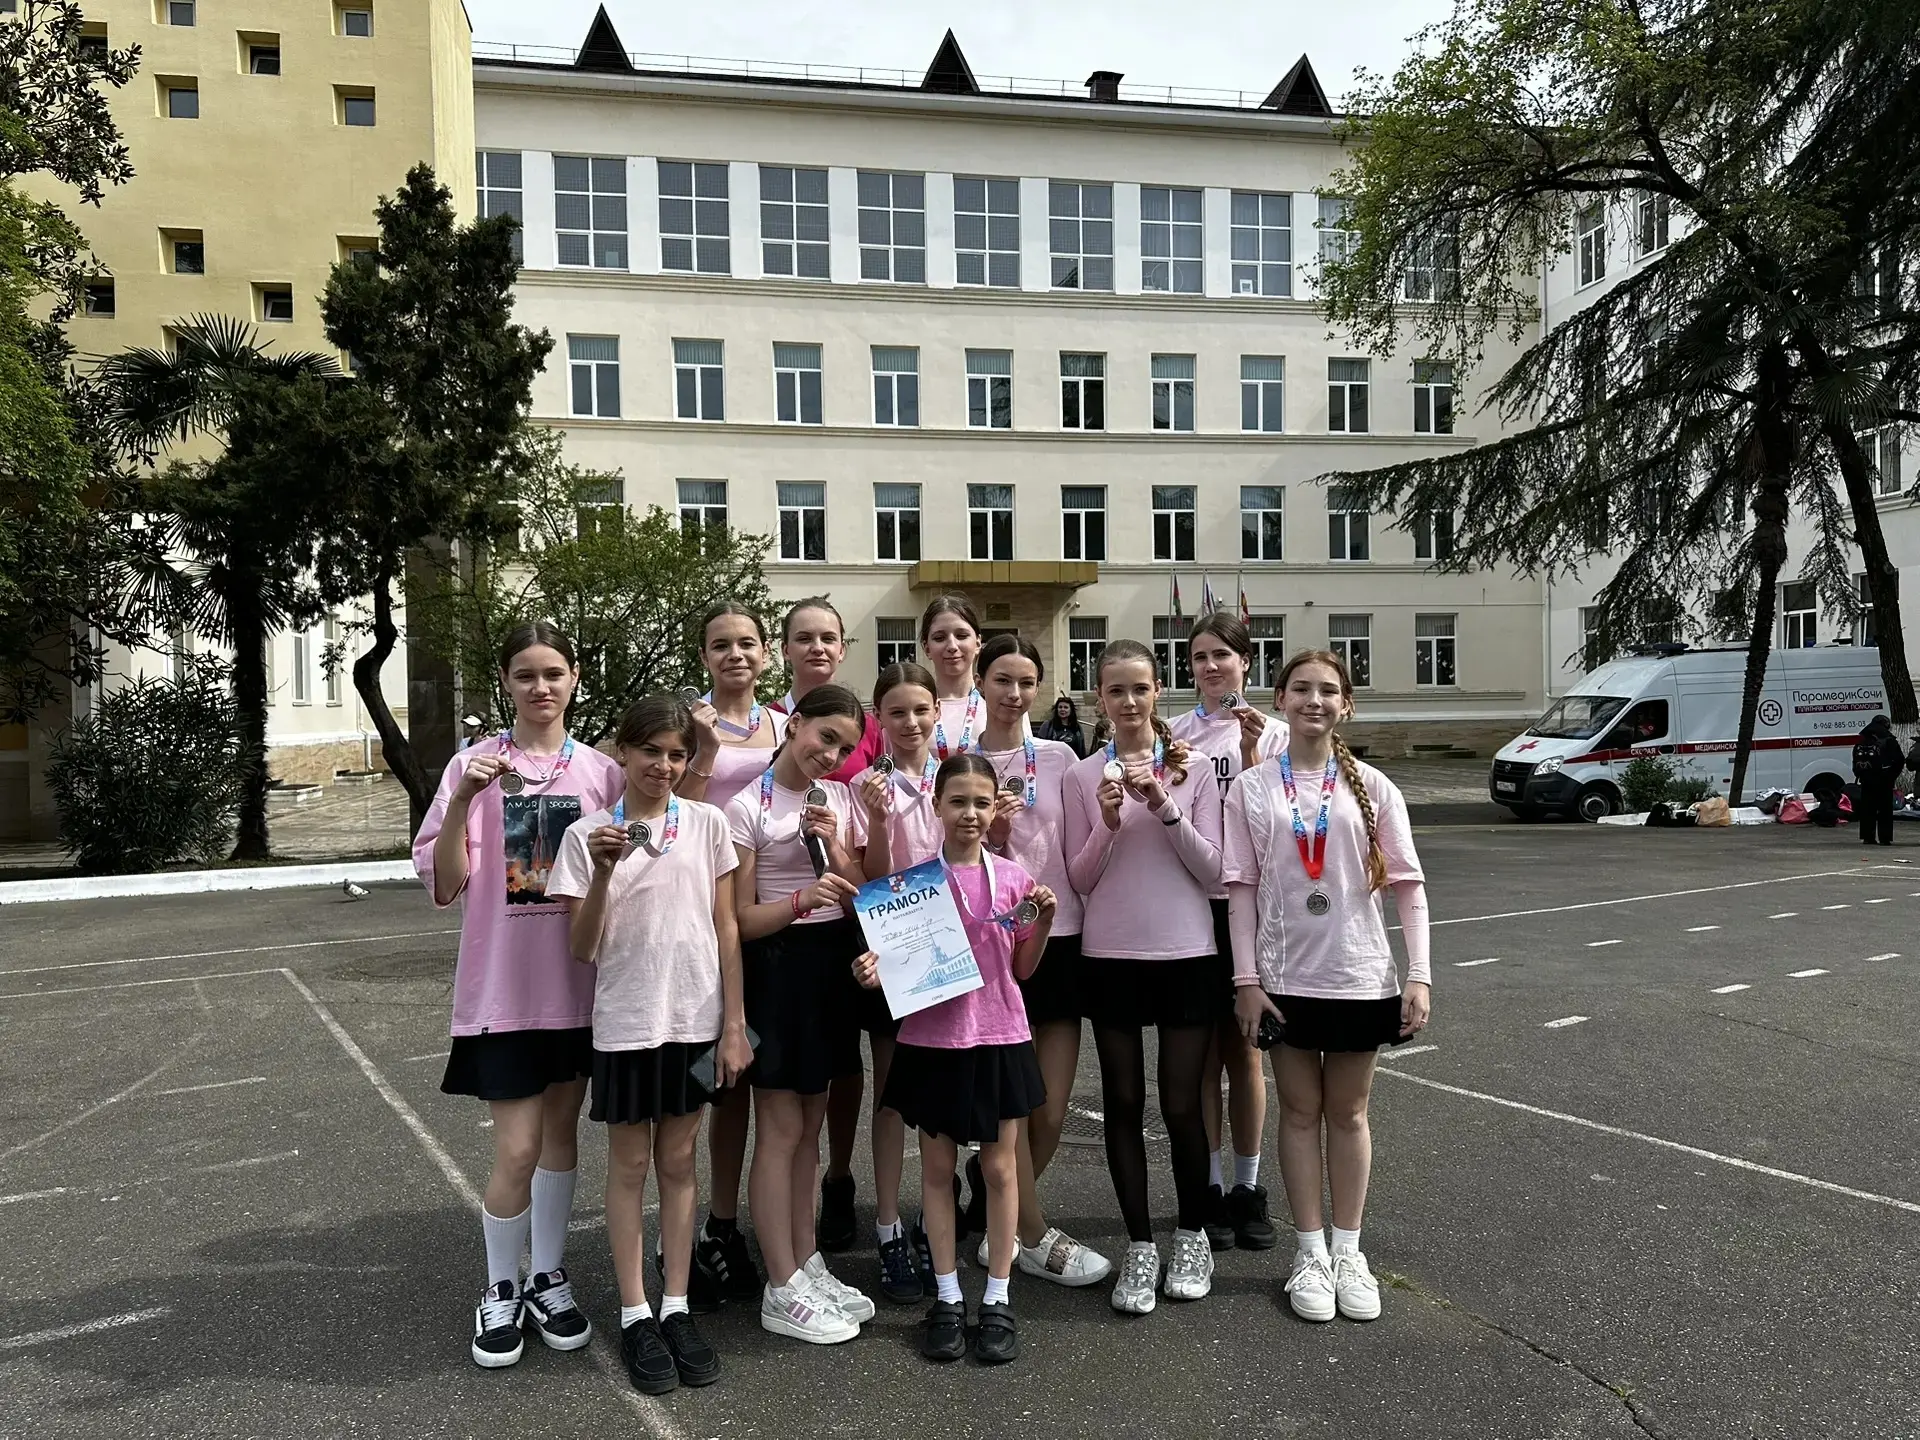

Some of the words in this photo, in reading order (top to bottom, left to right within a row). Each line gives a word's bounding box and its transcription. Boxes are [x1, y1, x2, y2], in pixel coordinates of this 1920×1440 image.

[1793, 688, 1882, 704] ПарамедикСочи
[1825, 704, 1849, 712] СКОРАЯ
[1850, 703, 1880, 711] ПОМОЩЬ
[1694, 743, 1738, 752] МЕДИЦИНСКА
[1794, 738, 1823, 747] ПОМОЩЬ
[506, 801, 538, 809] AMUR
[1319, 804, 1329, 822] СОЧИ
[1291, 807, 1302, 825] СОЧИ
[868, 886, 940, 920] ГРАМОТА
